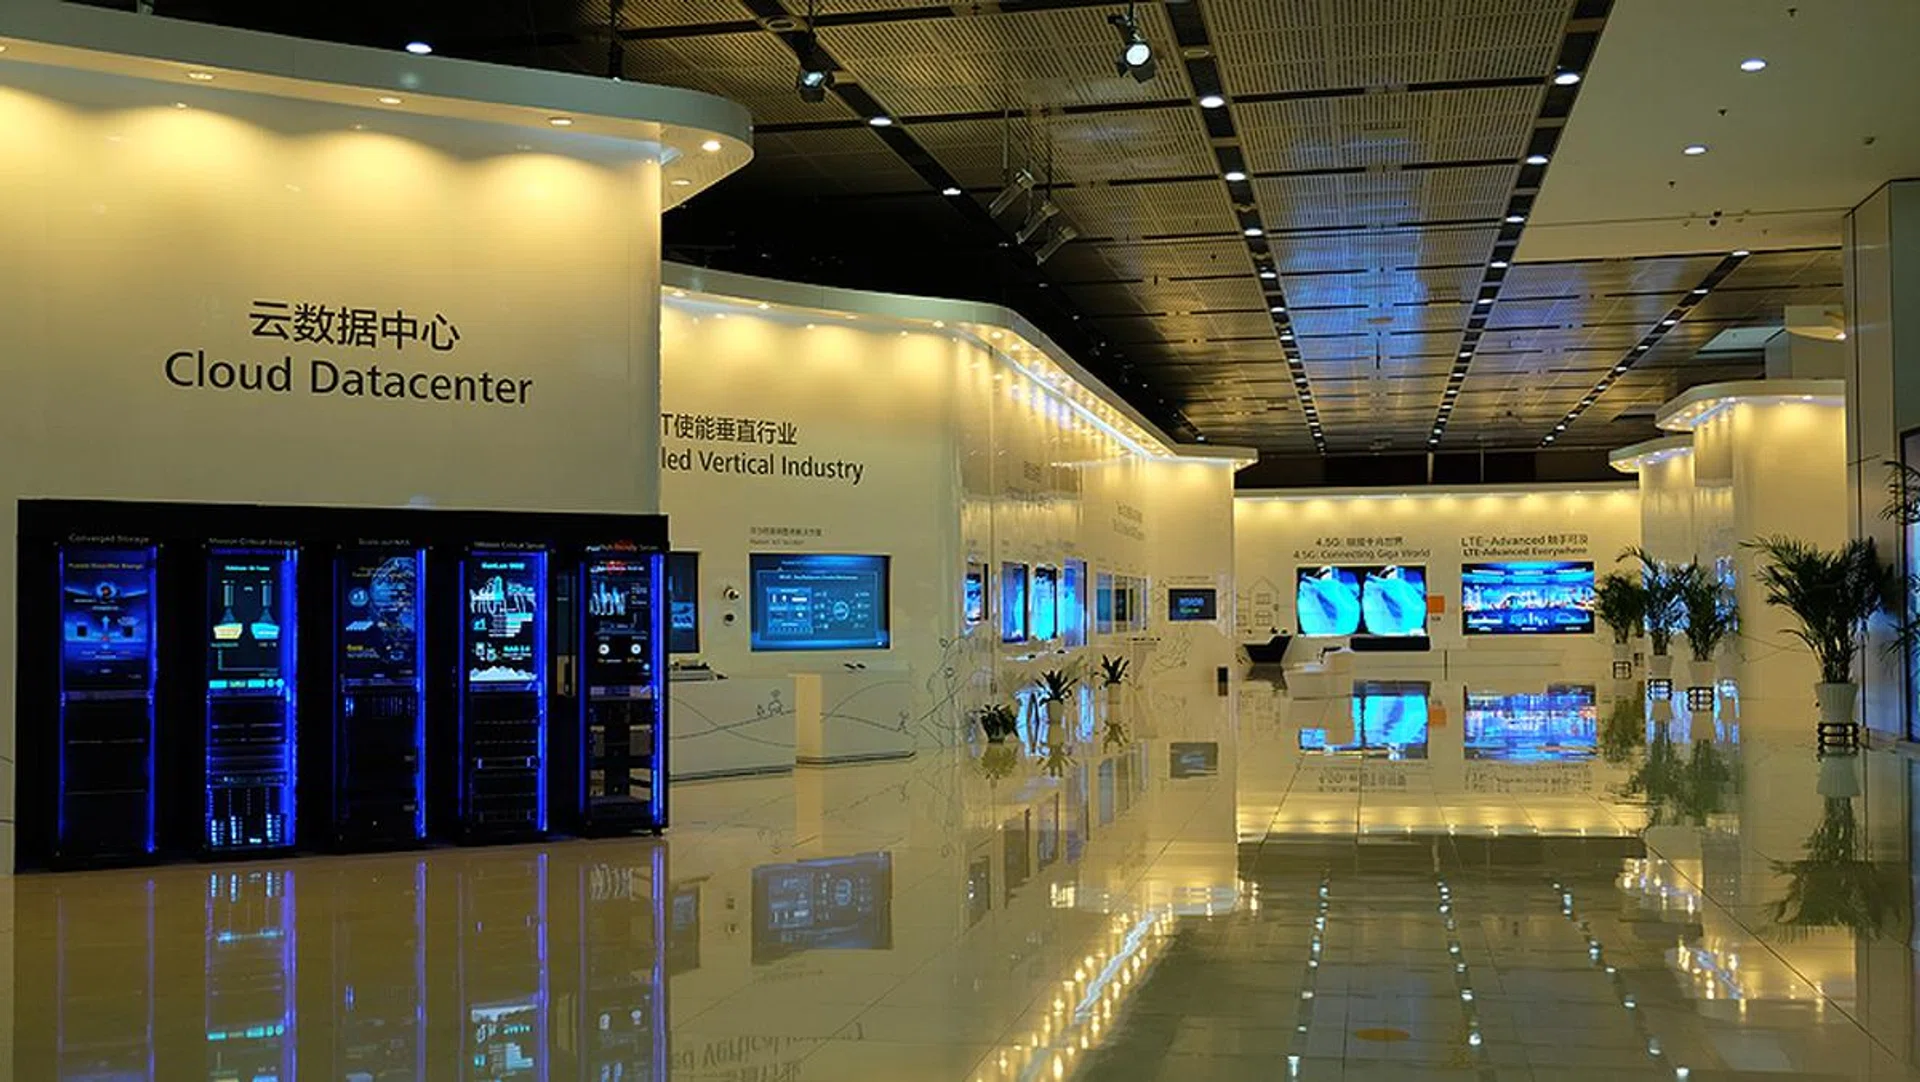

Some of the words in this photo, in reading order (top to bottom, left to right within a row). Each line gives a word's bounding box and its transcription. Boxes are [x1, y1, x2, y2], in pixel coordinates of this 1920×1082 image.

[249, 300, 460, 352] 云数据中心
[164, 350, 292, 392] Cloud
[310, 359, 533, 405] Datacenter
[661, 413, 798, 446] T使能垂直行业
[698, 449, 775, 476] Vertical
[781, 455, 864, 486] Industry
[1320, 550, 1375, 560] Connecting
